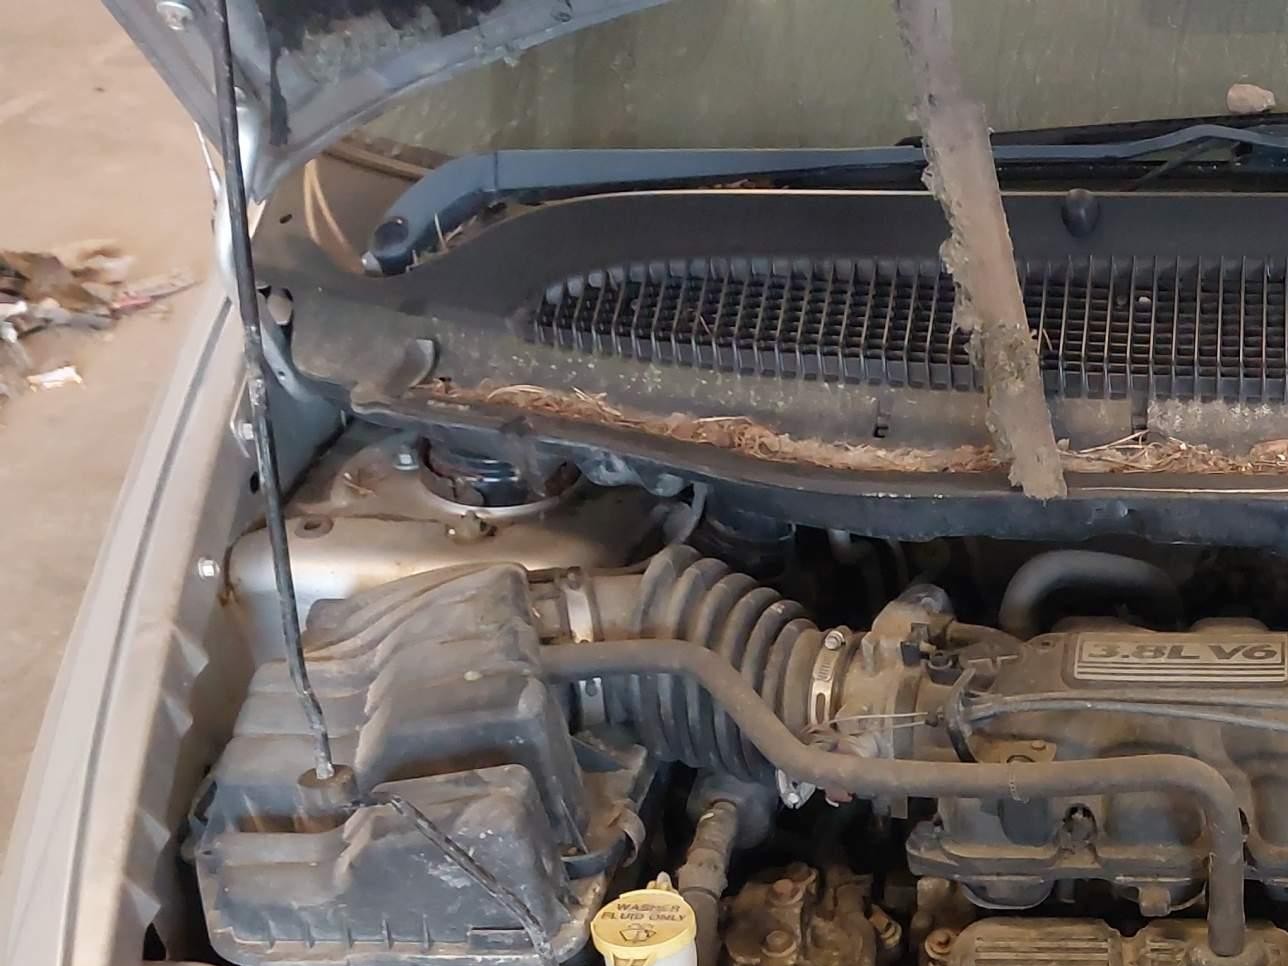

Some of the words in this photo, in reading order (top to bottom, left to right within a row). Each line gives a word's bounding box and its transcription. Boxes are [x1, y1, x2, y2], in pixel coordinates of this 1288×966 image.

[1088, 643, 1200, 660] 3.8L
[1208, 643, 1278, 660] V6
[617, 904, 680, 912] WASHER
[601, 912, 644, 920] FLUID
[648, 913, 686, 921] ONLY
